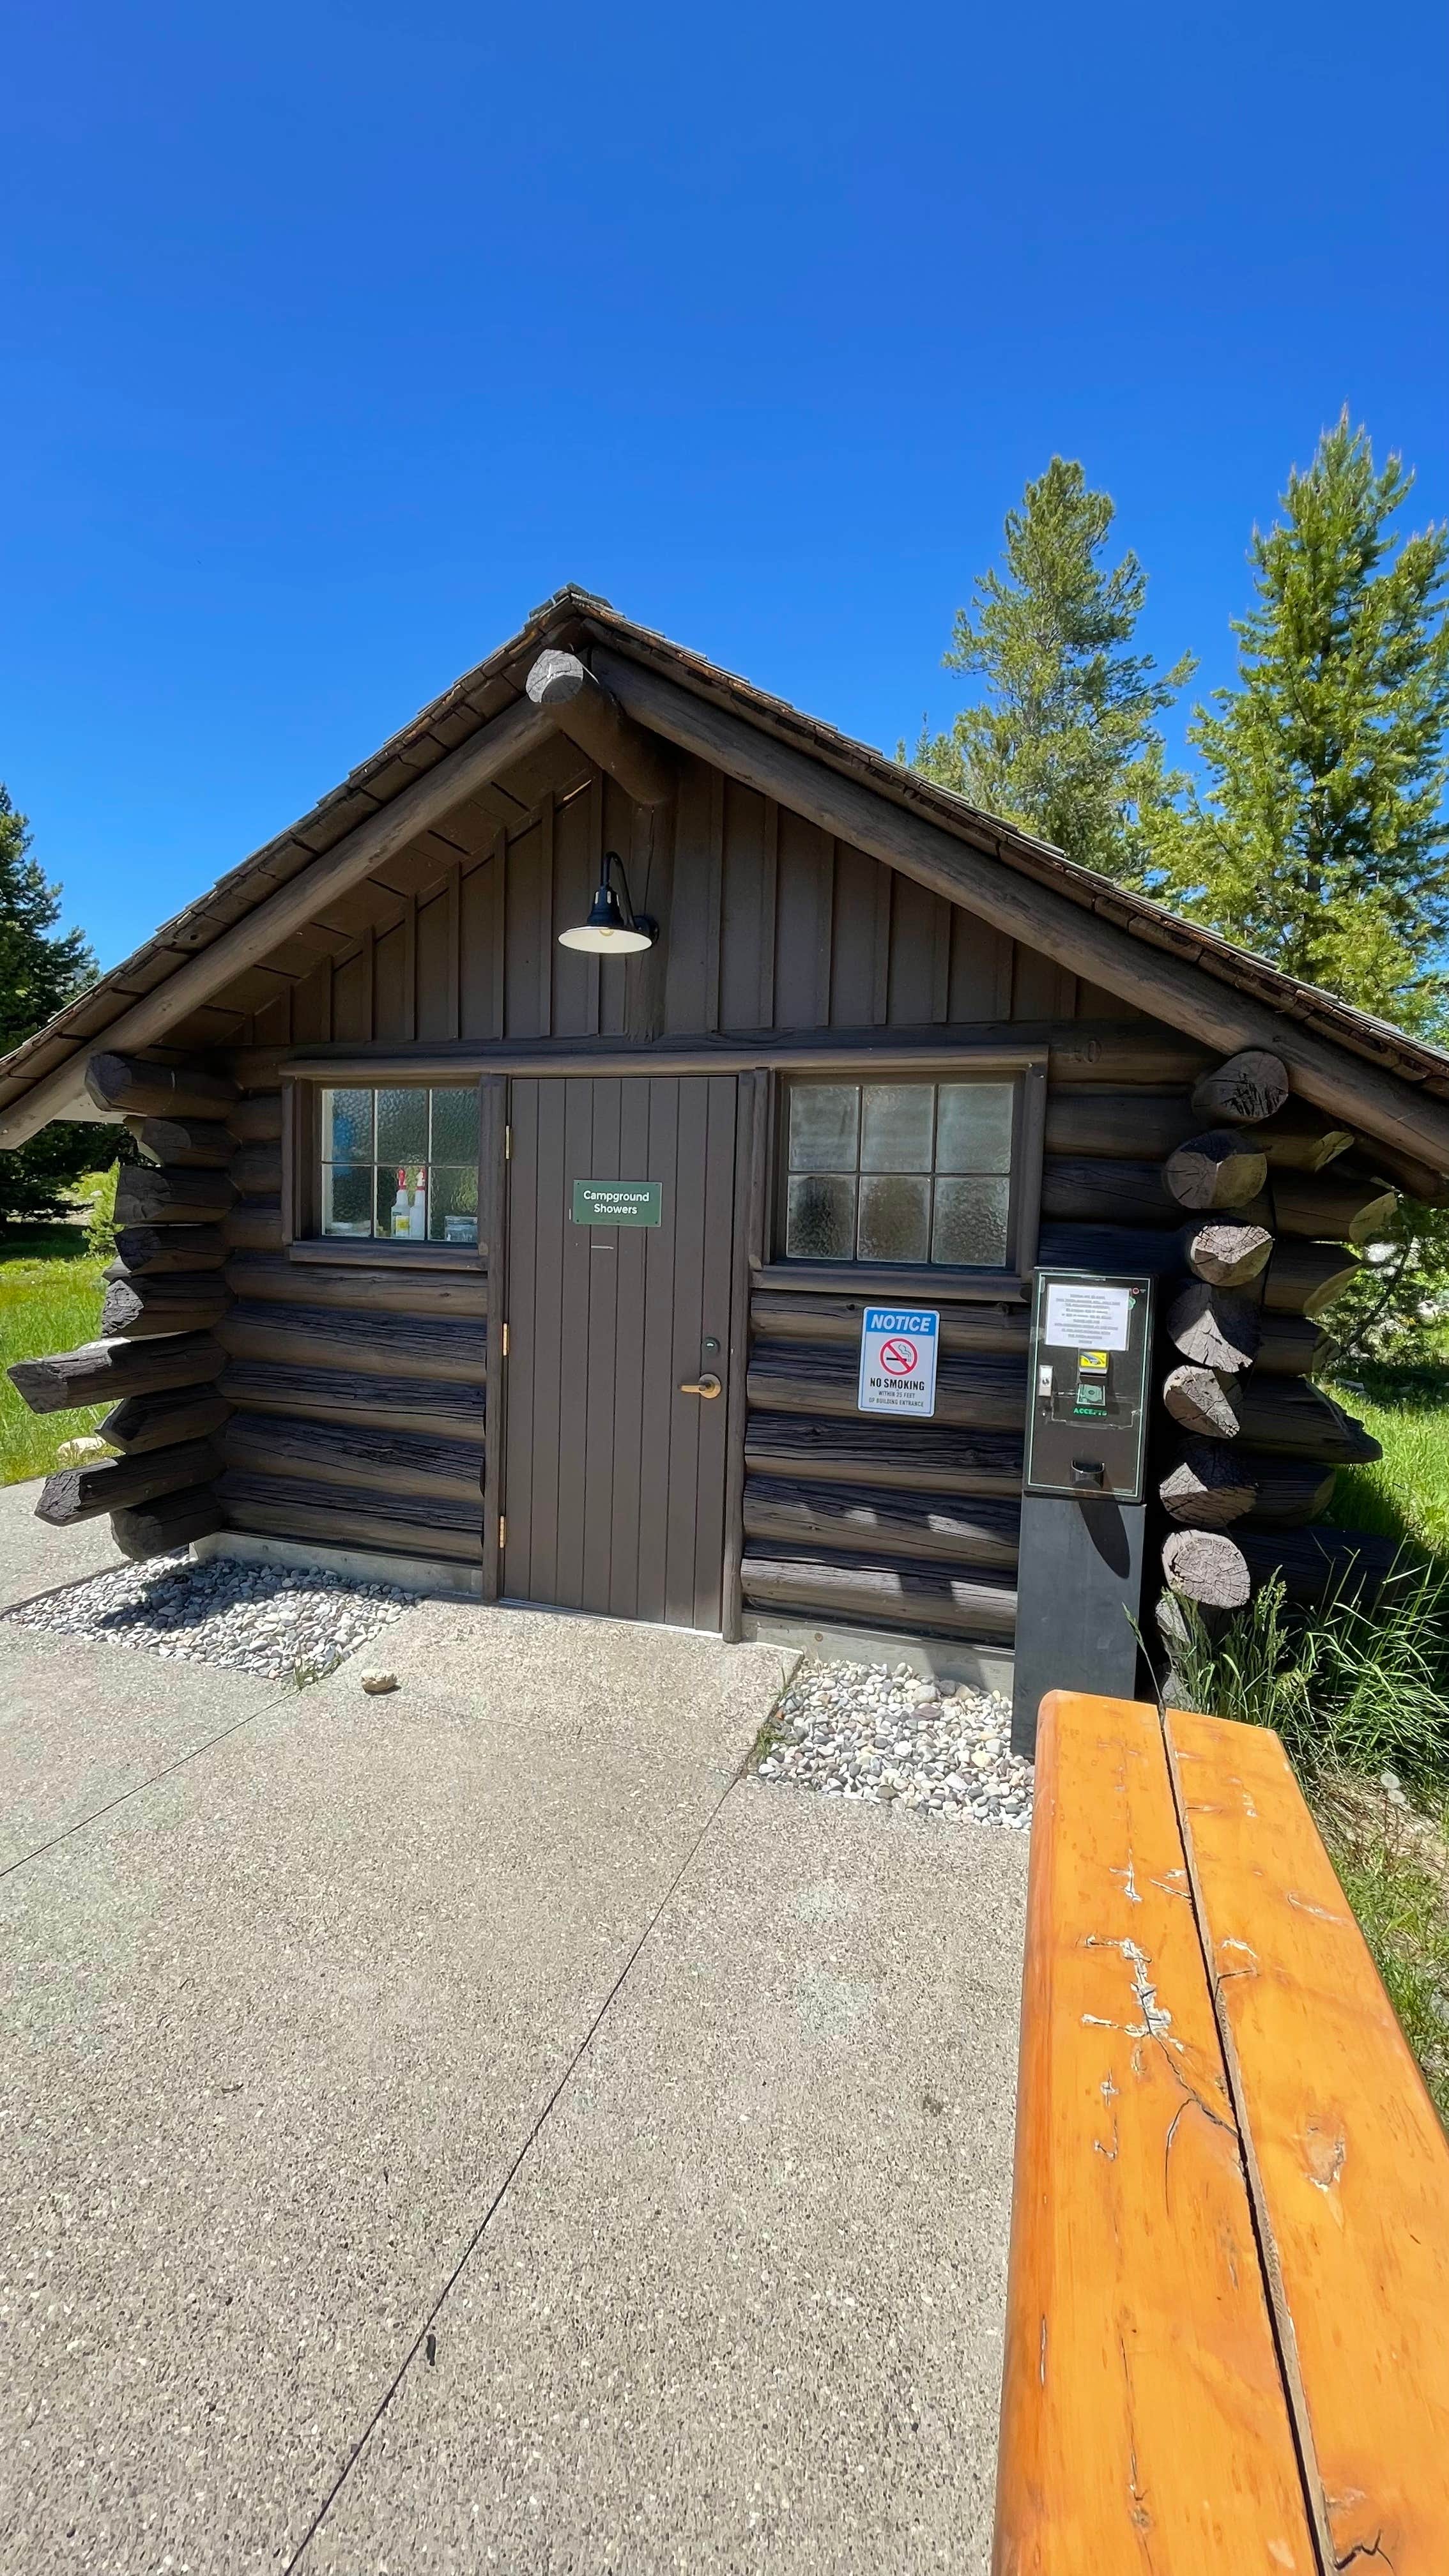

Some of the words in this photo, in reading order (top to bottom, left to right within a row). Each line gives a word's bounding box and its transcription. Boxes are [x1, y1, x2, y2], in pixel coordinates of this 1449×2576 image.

[583, 1190, 650, 1202] Campground
[594, 1204, 638, 1214] Showers
[871, 1314, 931, 1332] NOTICE
[870, 1377, 882, 1387] NO
[884, 1378, 925, 1391] SMOKING
